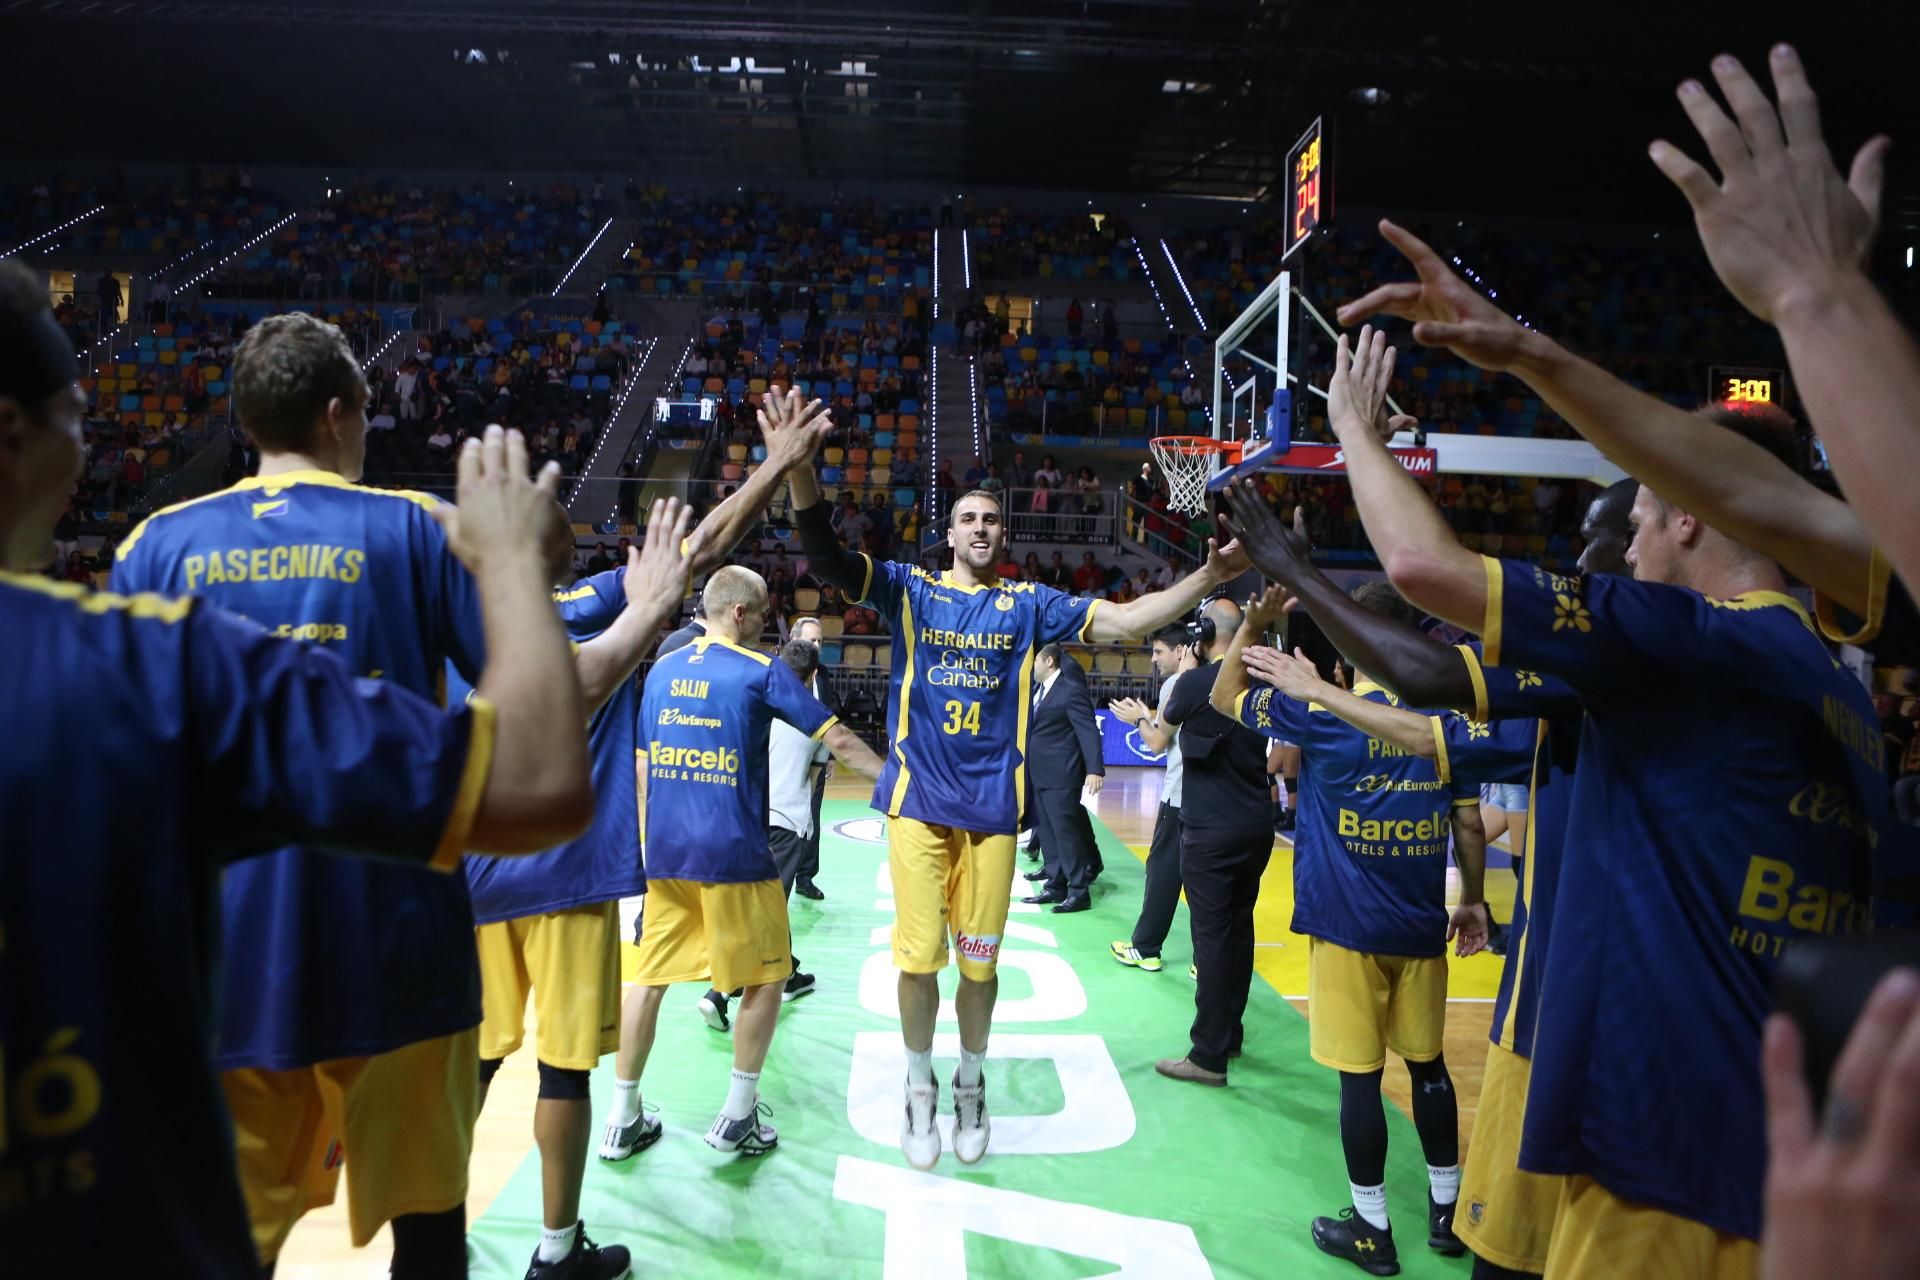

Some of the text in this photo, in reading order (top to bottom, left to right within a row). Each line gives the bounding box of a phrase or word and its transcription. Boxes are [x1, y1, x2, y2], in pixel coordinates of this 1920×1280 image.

[1296, 173, 1320, 239] 24
[1728, 379, 1770, 402] 3:00
[184, 544, 366, 590] PASECNIKS
[921, 627, 1013, 650] HERBALIFE
[941, 650, 987, 671] Gran
[927, 665, 1000, 689] Canaria
[670, 679, 709, 699] SALIN
[943, 700, 981, 735] 34
[1346, 841, 1446, 856] OTELS & RESORT
